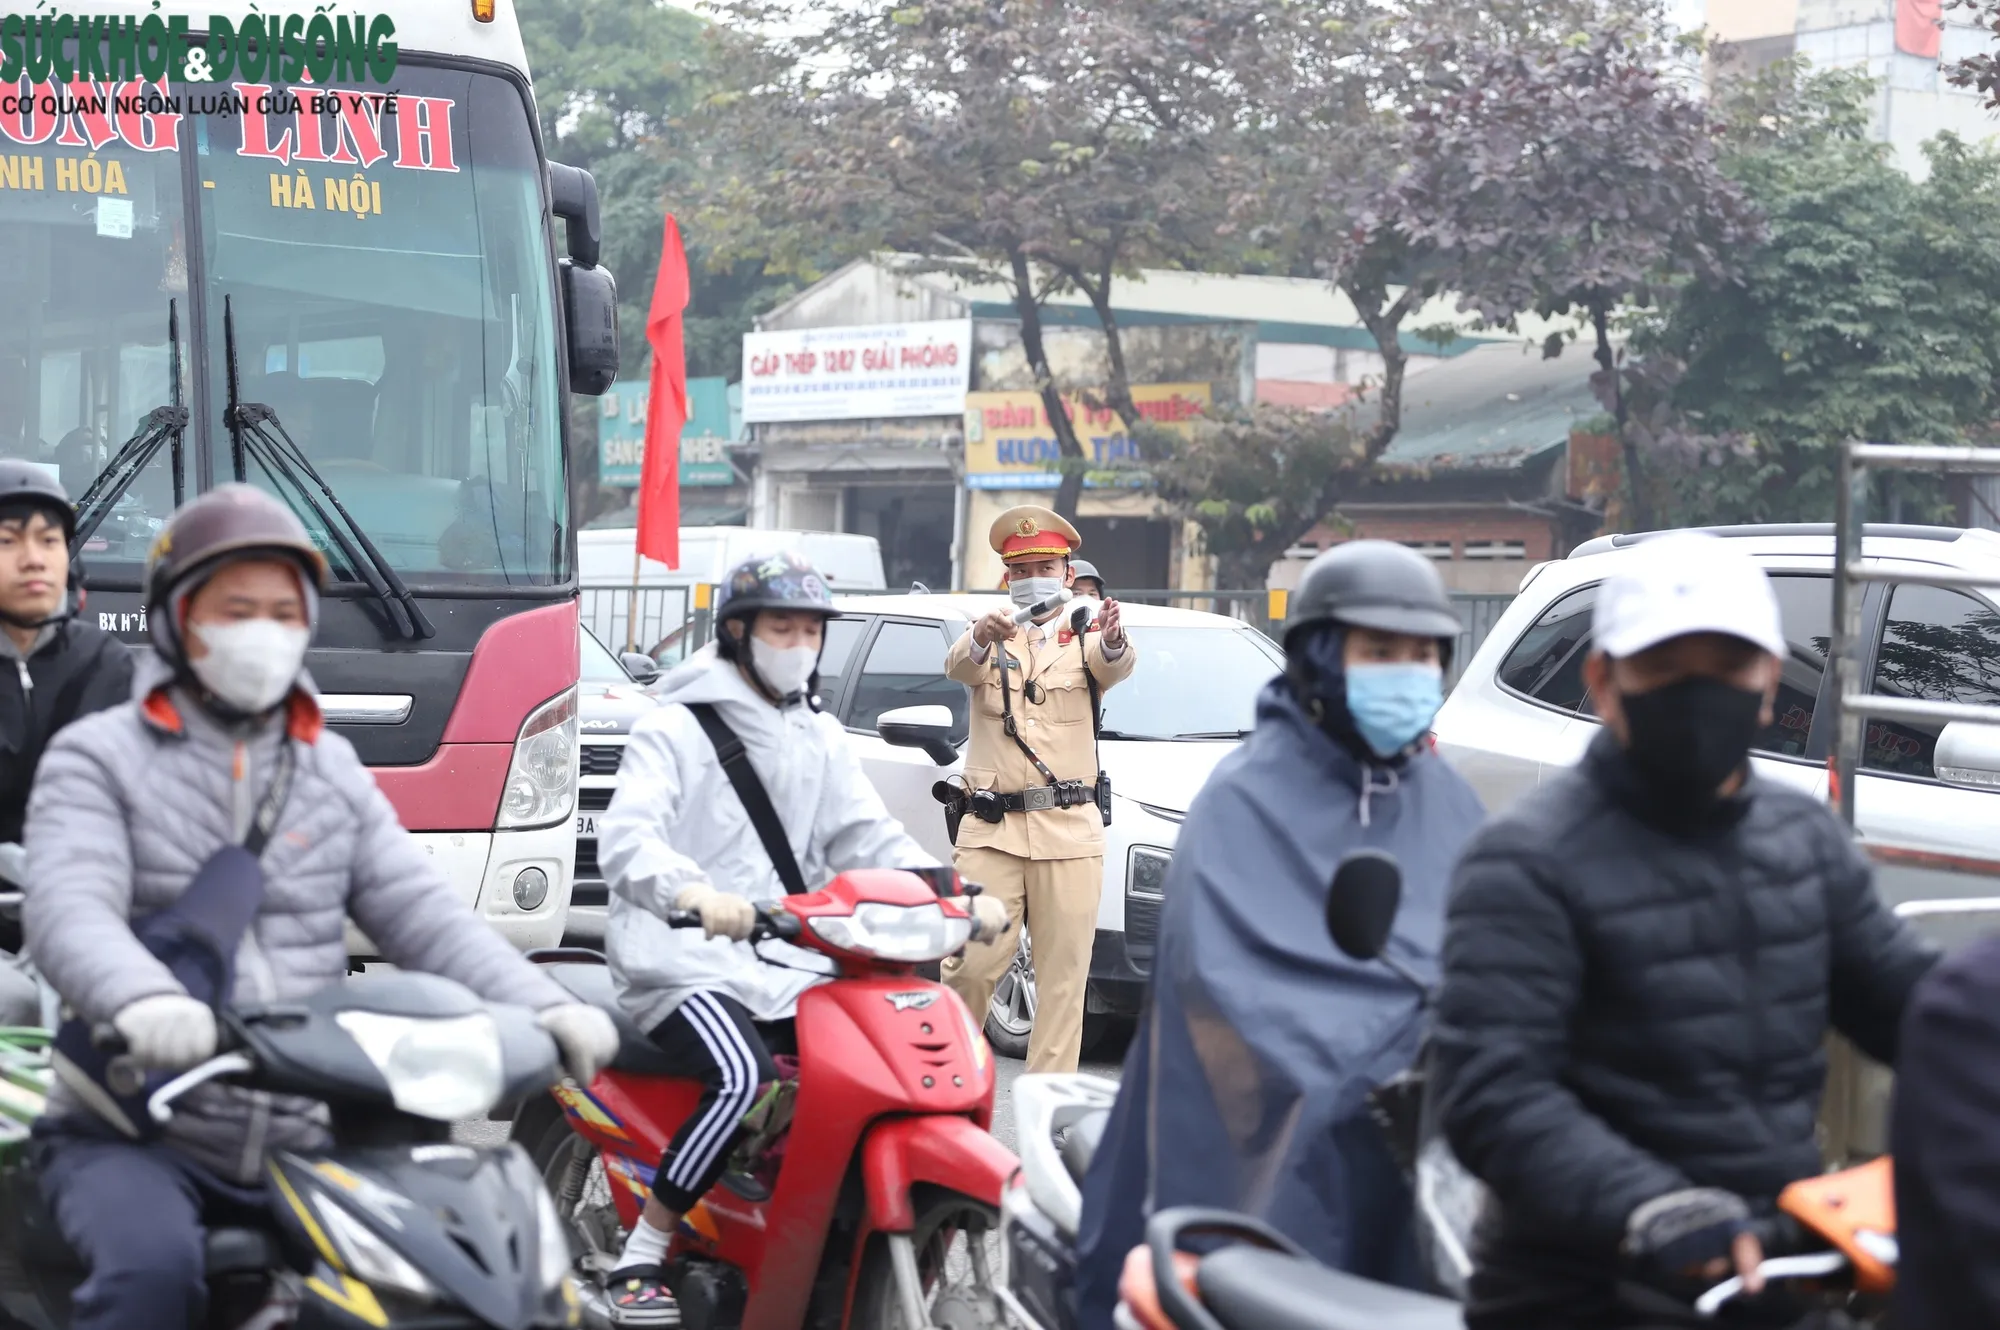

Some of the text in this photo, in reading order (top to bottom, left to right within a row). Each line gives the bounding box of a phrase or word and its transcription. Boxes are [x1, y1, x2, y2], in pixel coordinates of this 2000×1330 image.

[56, 152, 128, 194] HÓA
[270, 169, 316, 210] HÀ
[324, 173, 382, 219] NỘI
[98, 612, 118, 631] BX
